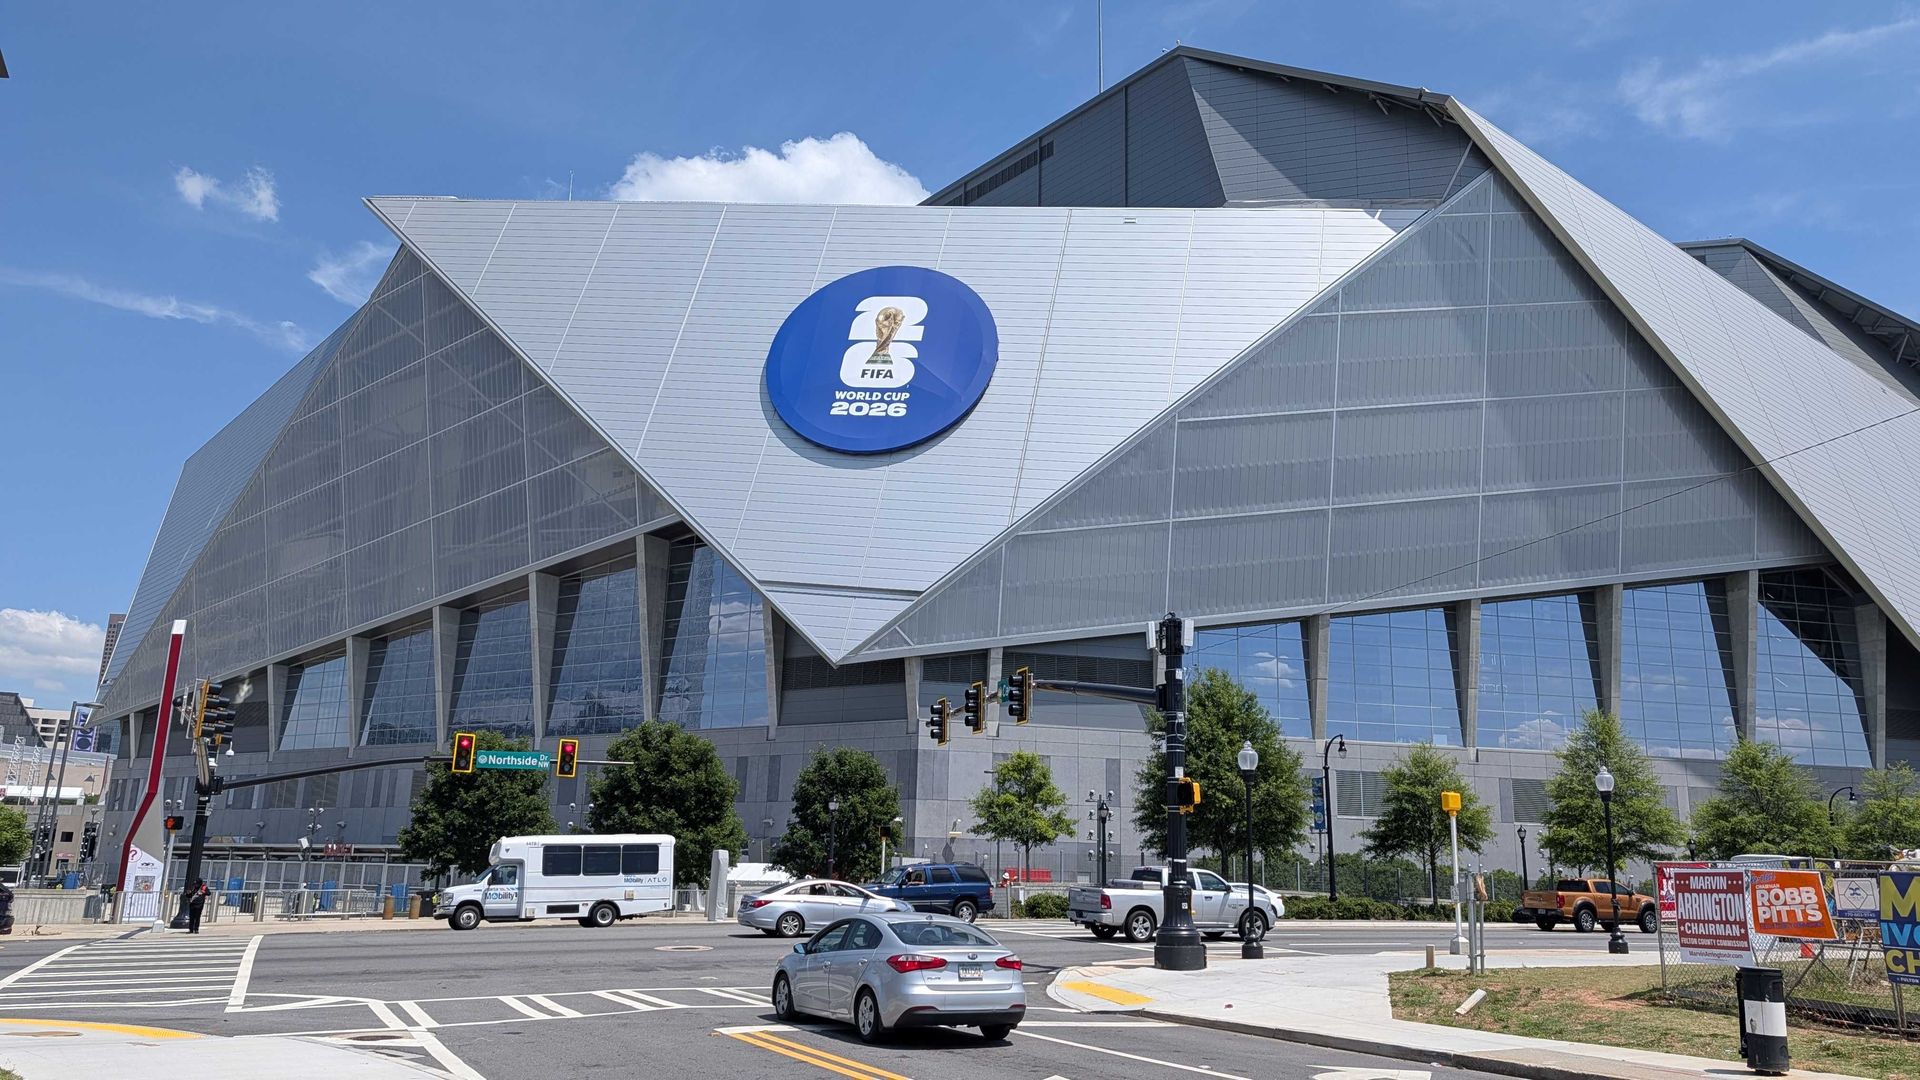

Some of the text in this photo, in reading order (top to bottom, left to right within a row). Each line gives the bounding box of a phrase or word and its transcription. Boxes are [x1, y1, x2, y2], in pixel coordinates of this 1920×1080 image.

[861, 369, 894, 379] FIFA
[835, 391, 910, 401] WORLD CUP
[830, 402, 907, 417] 2026
[488, 755, 538, 766] Northside
[1689, 876, 1727, 890] MARVIN
[1756, 886, 1818, 906] ROBB
[1677, 892, 1745, 921] ARRINGTON
[1757, 904, 1823, 923] PITTS
[1685, 922, 1741, 936] CHAIRMAN
